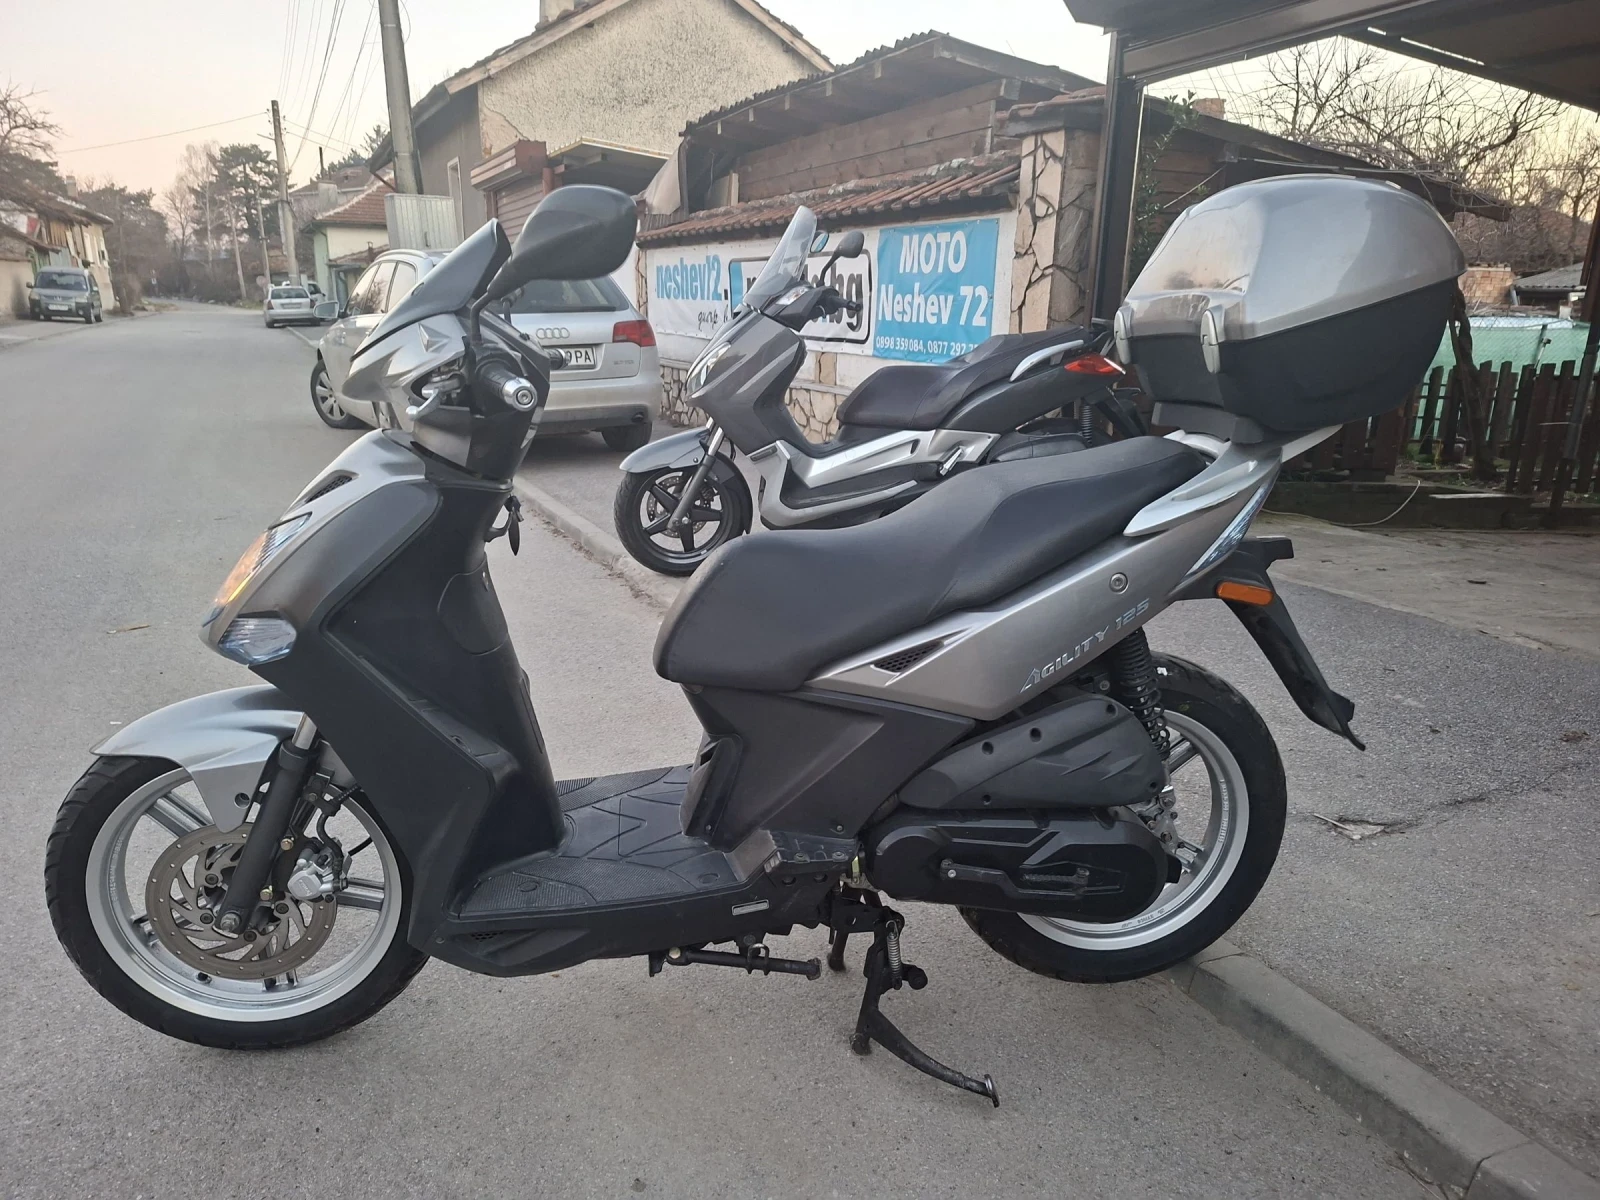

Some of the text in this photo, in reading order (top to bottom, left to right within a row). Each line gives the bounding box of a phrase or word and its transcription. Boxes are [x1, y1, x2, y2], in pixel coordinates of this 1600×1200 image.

[899, 230, 967, 274] MOTO
[878, 282, 954, 325] Neshev
[960, 285, 989, 327] 72
[876, 336, 895, 349] 0898
[927, 341, 948, 354] 0877
[1115, 598, 1150, 630] 125
